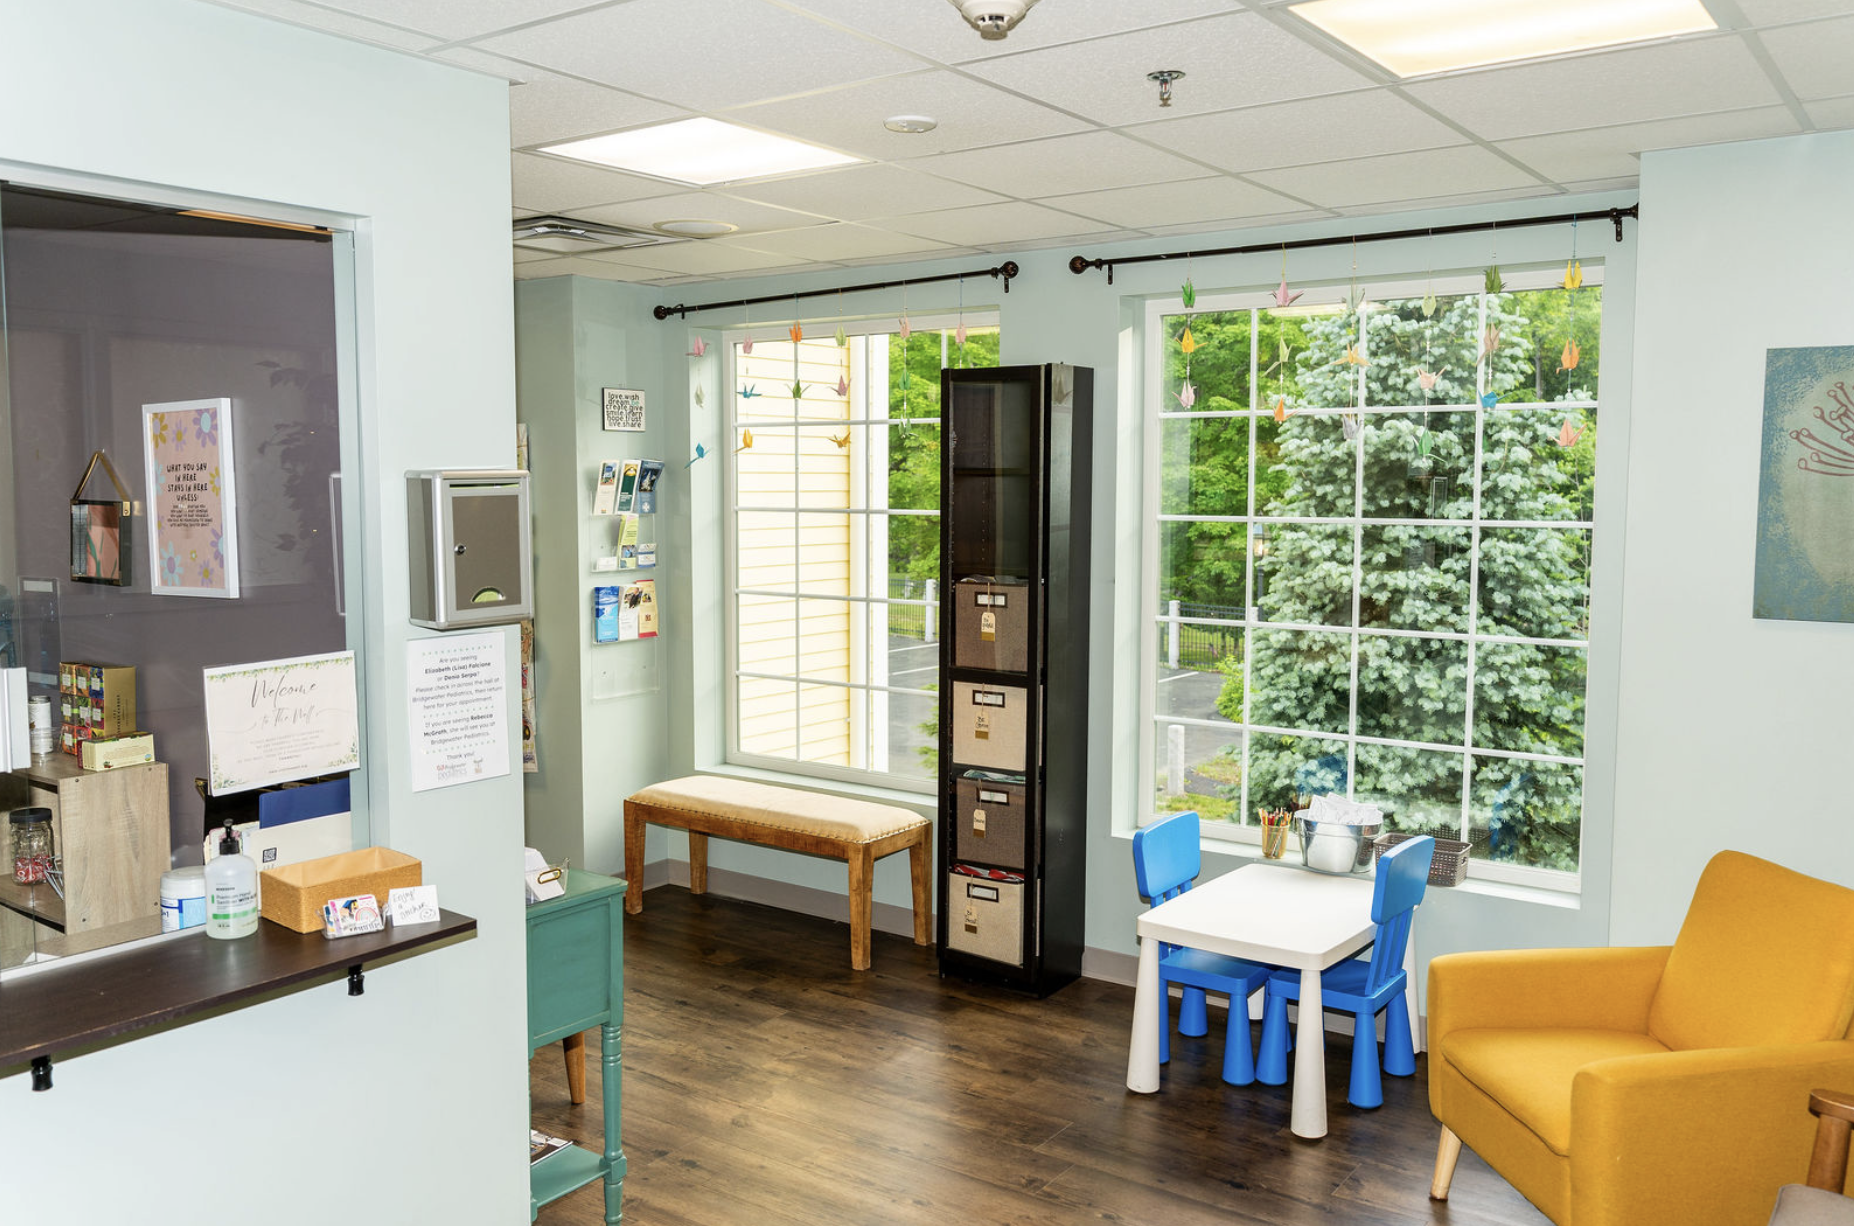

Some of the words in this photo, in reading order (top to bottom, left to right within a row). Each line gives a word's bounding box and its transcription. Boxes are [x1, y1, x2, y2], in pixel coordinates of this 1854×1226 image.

[166, 463, 181, 473] WHAT
[183, 463, 195, 471] YOU
[196, 462, 208, 471] SAY
[182, 473, 196, 481] HERE
[167, 483, 184, 492] STAYS
[193, 482, 208, 491] HERE
[460, 654, 478, 662] seeing
[424, 666, 451, 675] Elizabeth
[251, 670, 317, 708] Welcome
[434, 684, 450, 693] check
[470, 713, 494, 721] Rebecca
